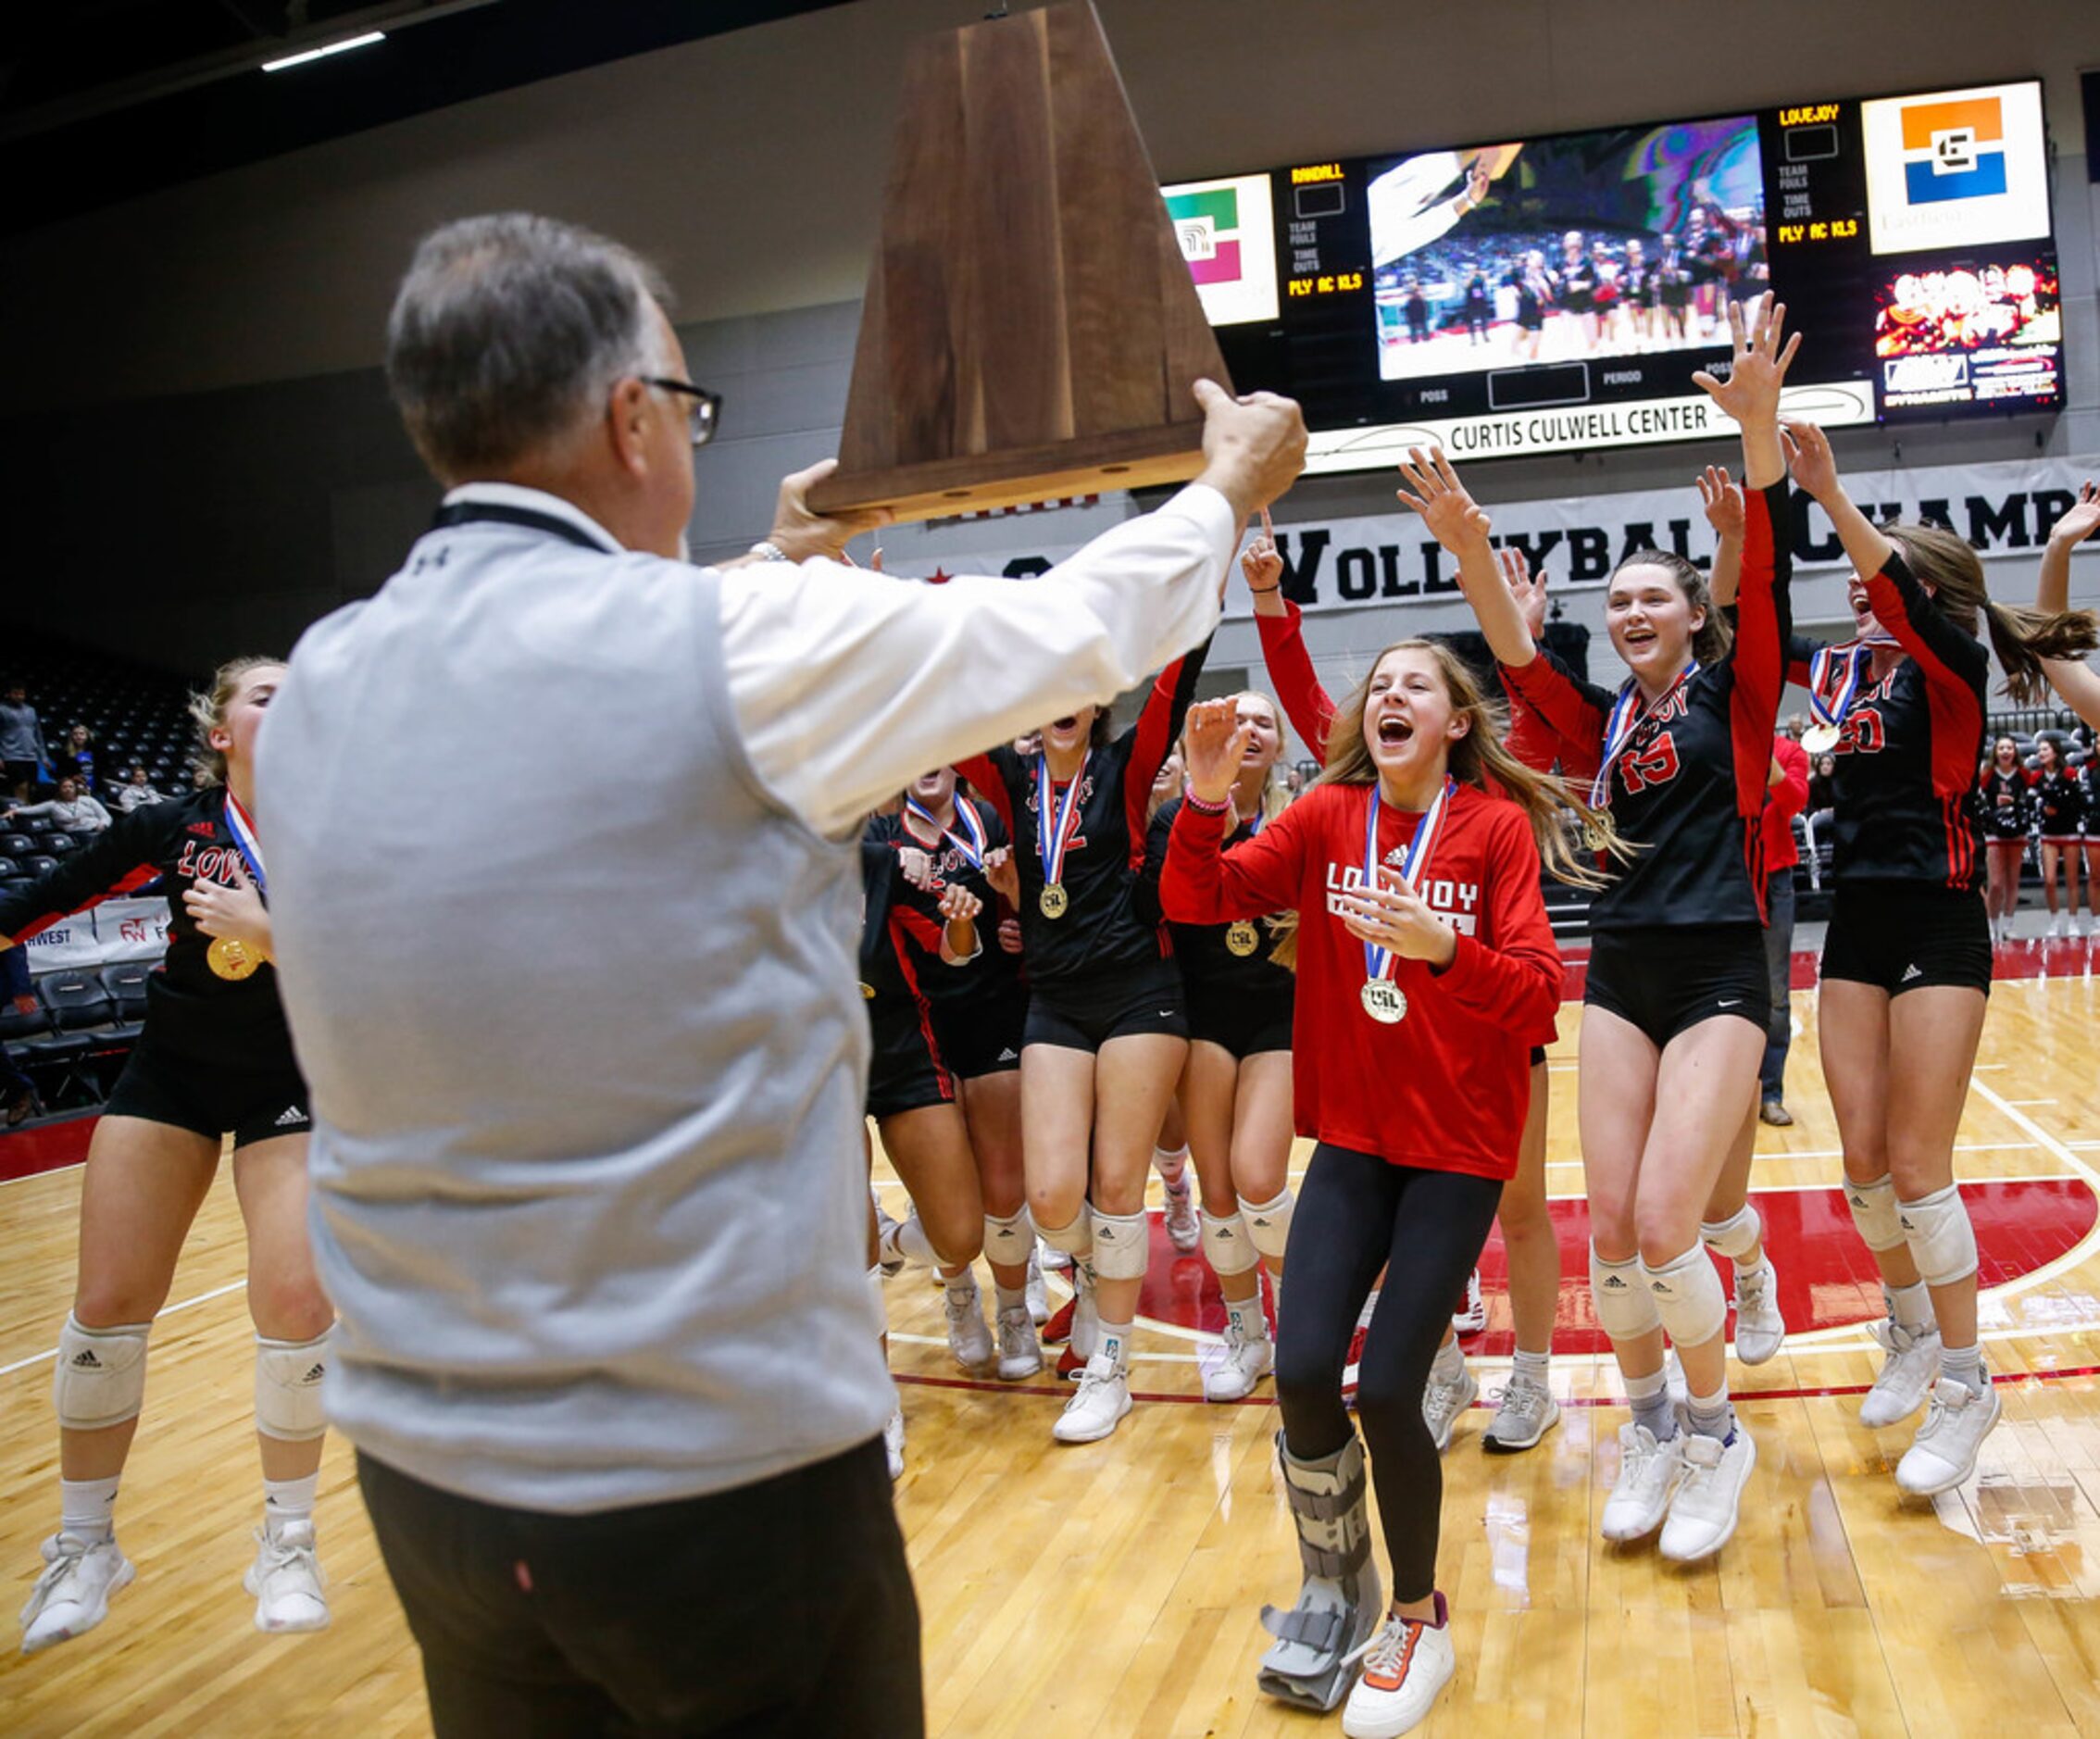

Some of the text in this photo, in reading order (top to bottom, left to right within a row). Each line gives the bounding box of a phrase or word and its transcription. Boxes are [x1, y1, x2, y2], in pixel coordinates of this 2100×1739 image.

[1779, 104, 1839, 126] LOVEJOY
[1291, 164, 1344, 183] RANDALL
[1779, 165, 1807, 177] TEAM
[1780, 177, 1808, 190] FOULS
[1783, 193, 1809, 206] TIME
[1783, 206, 1812, 219] OUTS
[1289, 221, 1317, 231] TEAM
[1289, 232, 1317, 245] FOULS
[1779, 224, 1805, 244] PLY
[1294, 248, 1319, 260] TIME
[1294, 260, 1320, 273] OUTS
[1603, 370, 1642, 385] PERIOD
[1419, 389, 1449, 404] POSS
[1451, 405, 1708, 451] CURTIS CULWELL CENTER
